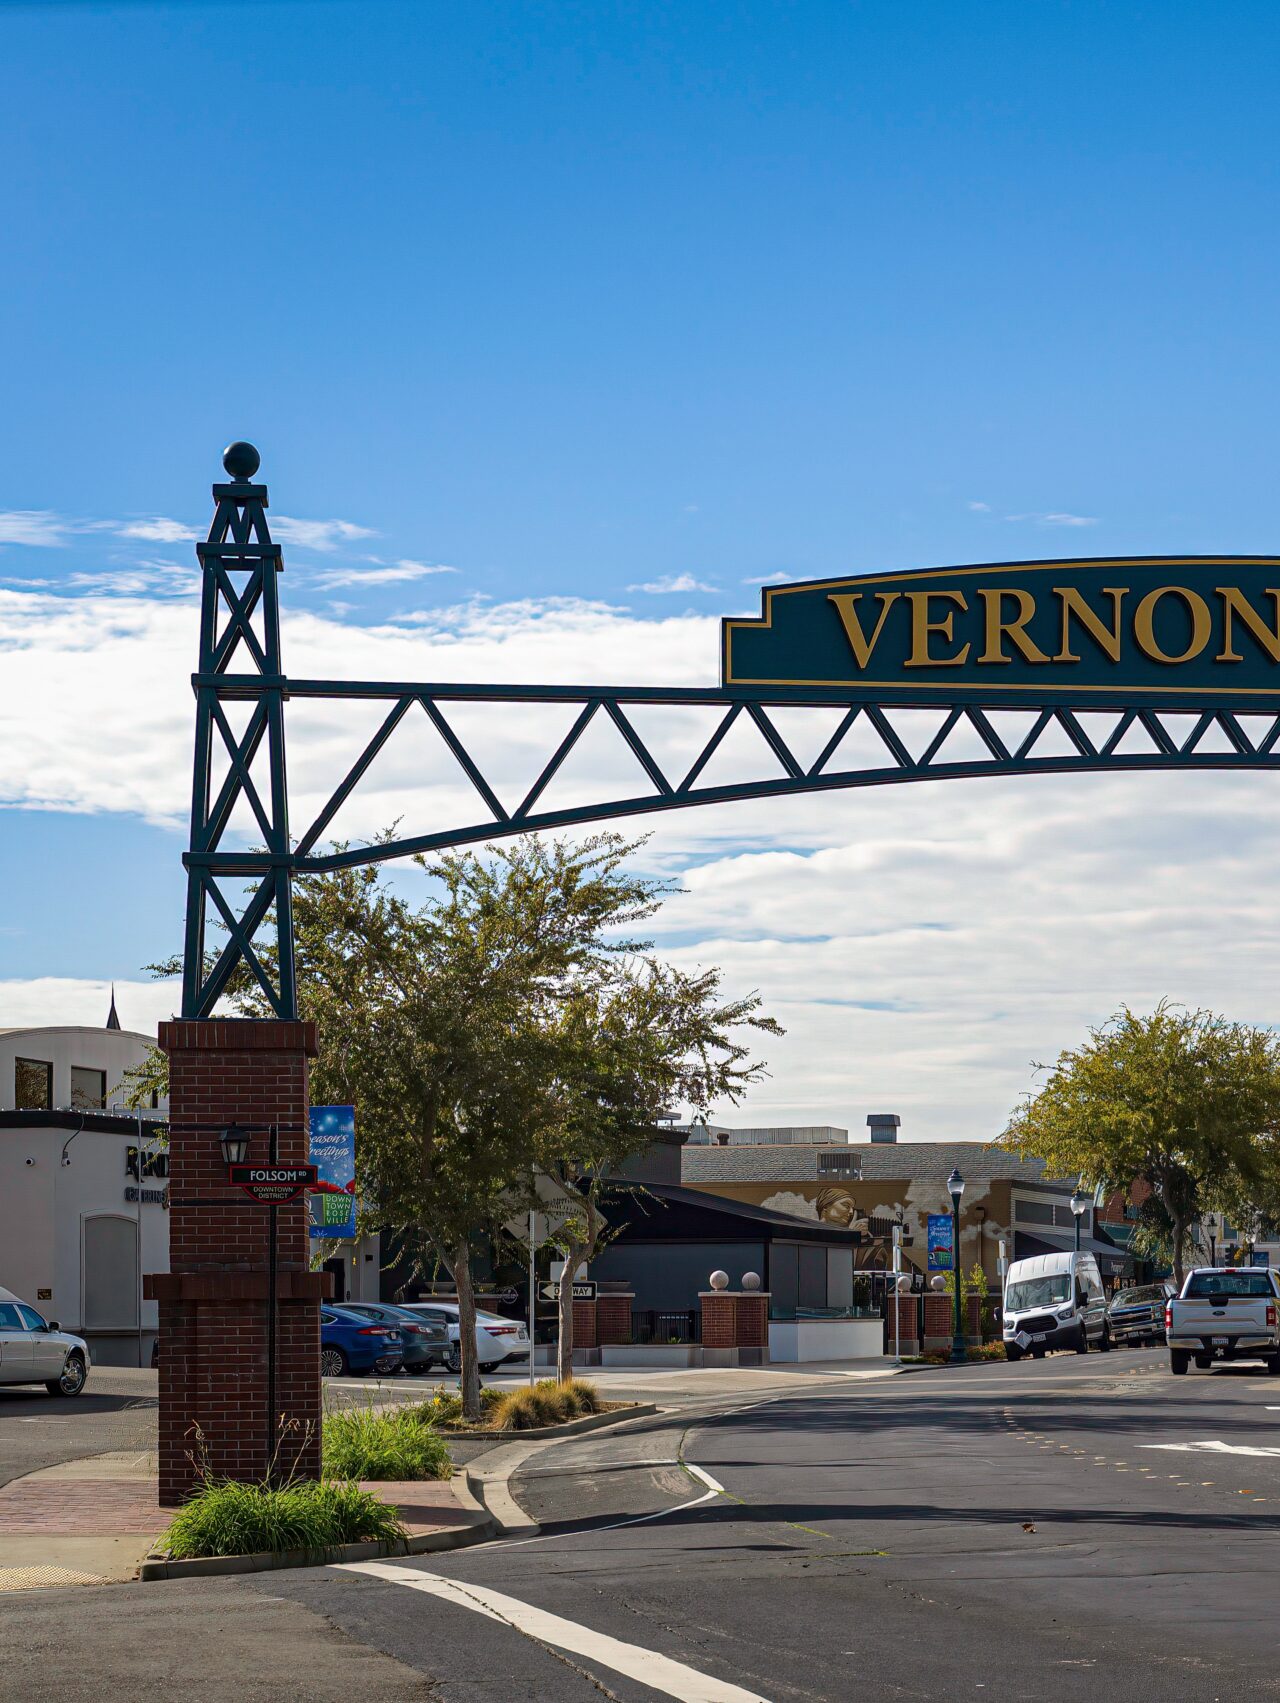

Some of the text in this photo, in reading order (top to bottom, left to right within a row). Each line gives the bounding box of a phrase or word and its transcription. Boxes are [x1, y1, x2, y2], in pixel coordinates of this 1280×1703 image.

[250, 1170, 297, 1181] FOLSOM
[326, 1195, 351, 1203] DOWN
[326, 1202, 350, 1210] TOWN
[572, 1287, 589, 1295] WAY
